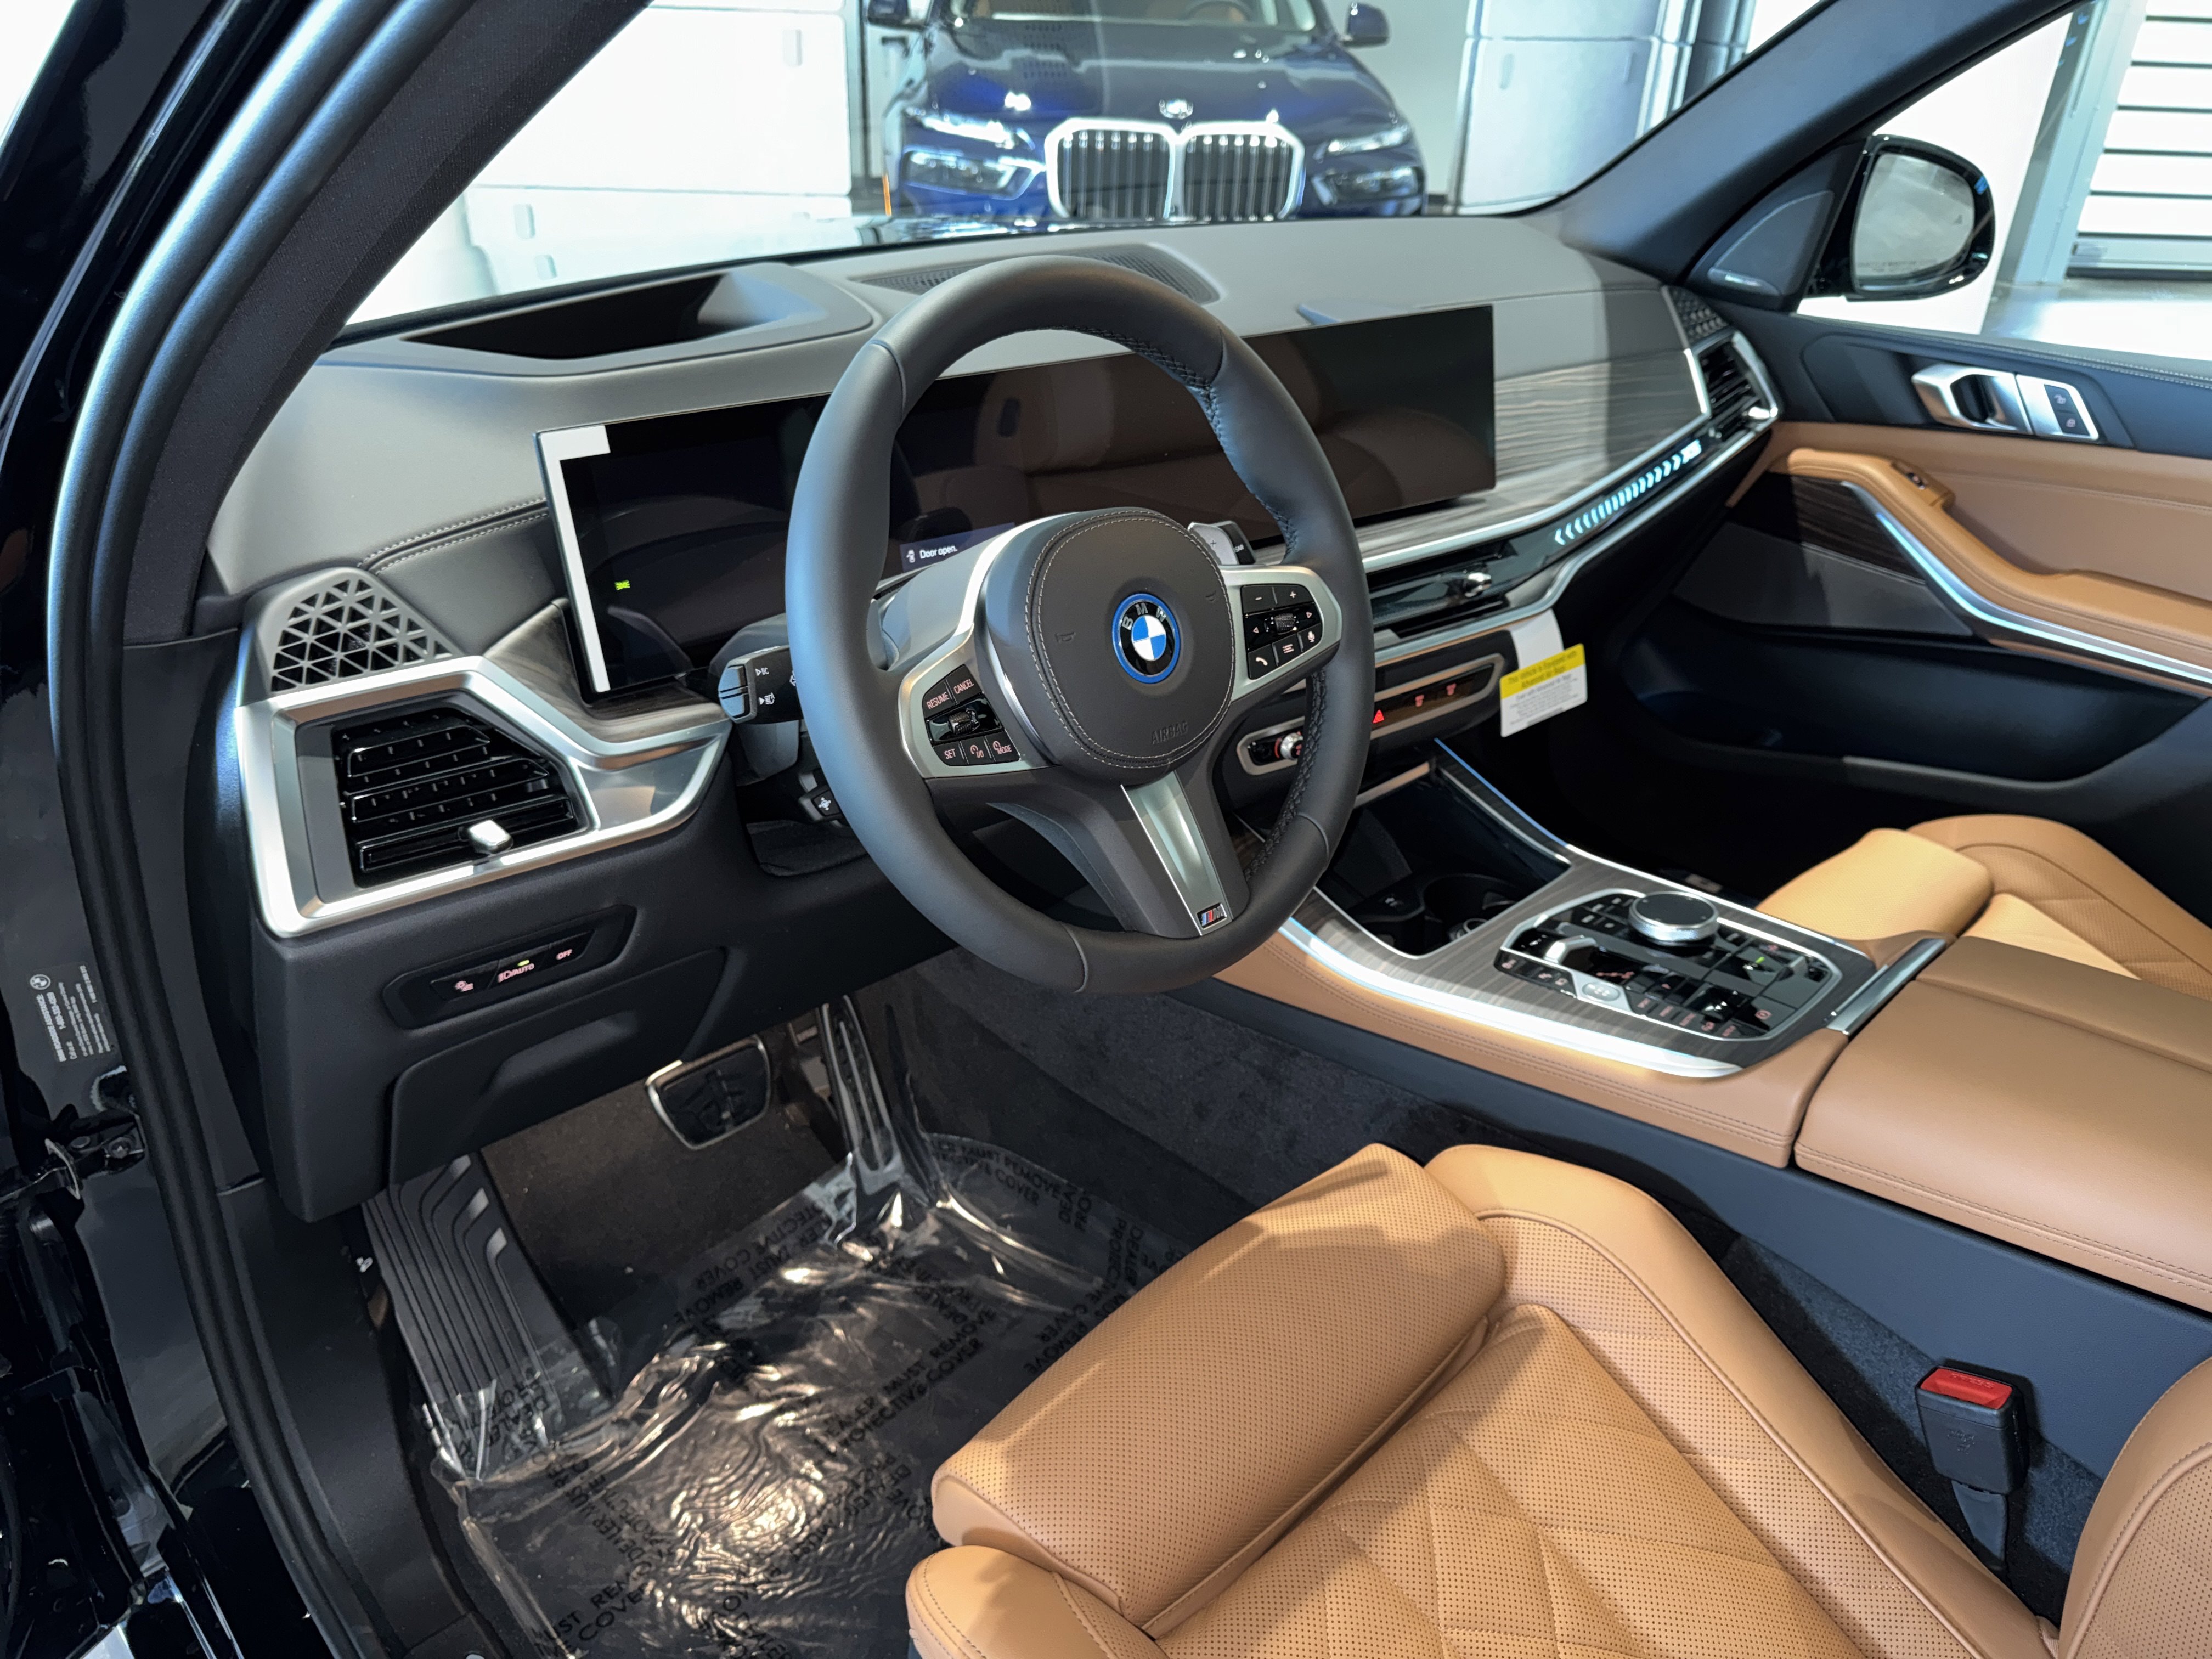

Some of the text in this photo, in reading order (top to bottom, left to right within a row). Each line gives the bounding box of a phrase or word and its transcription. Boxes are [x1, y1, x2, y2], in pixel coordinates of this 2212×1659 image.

[919, 545, 958, 559] Door open.
[1121, 602, 1166, 630] BMW
[953, 679, 974, 695] CANCEL
[926, 691, 950, 709] RESUME
[1152, 720, 1188, 745] AIRBAG
[944, 748, 956, 759] SET
[996, 744, 1013, 755] MODE
[555, 949, 573, 960] OFF
[992, 1167, 1043, 1206] COVER
[692, 1246, 752, 1293] COVER
[923, 1335, 985, 1386] COVER
[590, 1510, 647, 1566] DEALER
